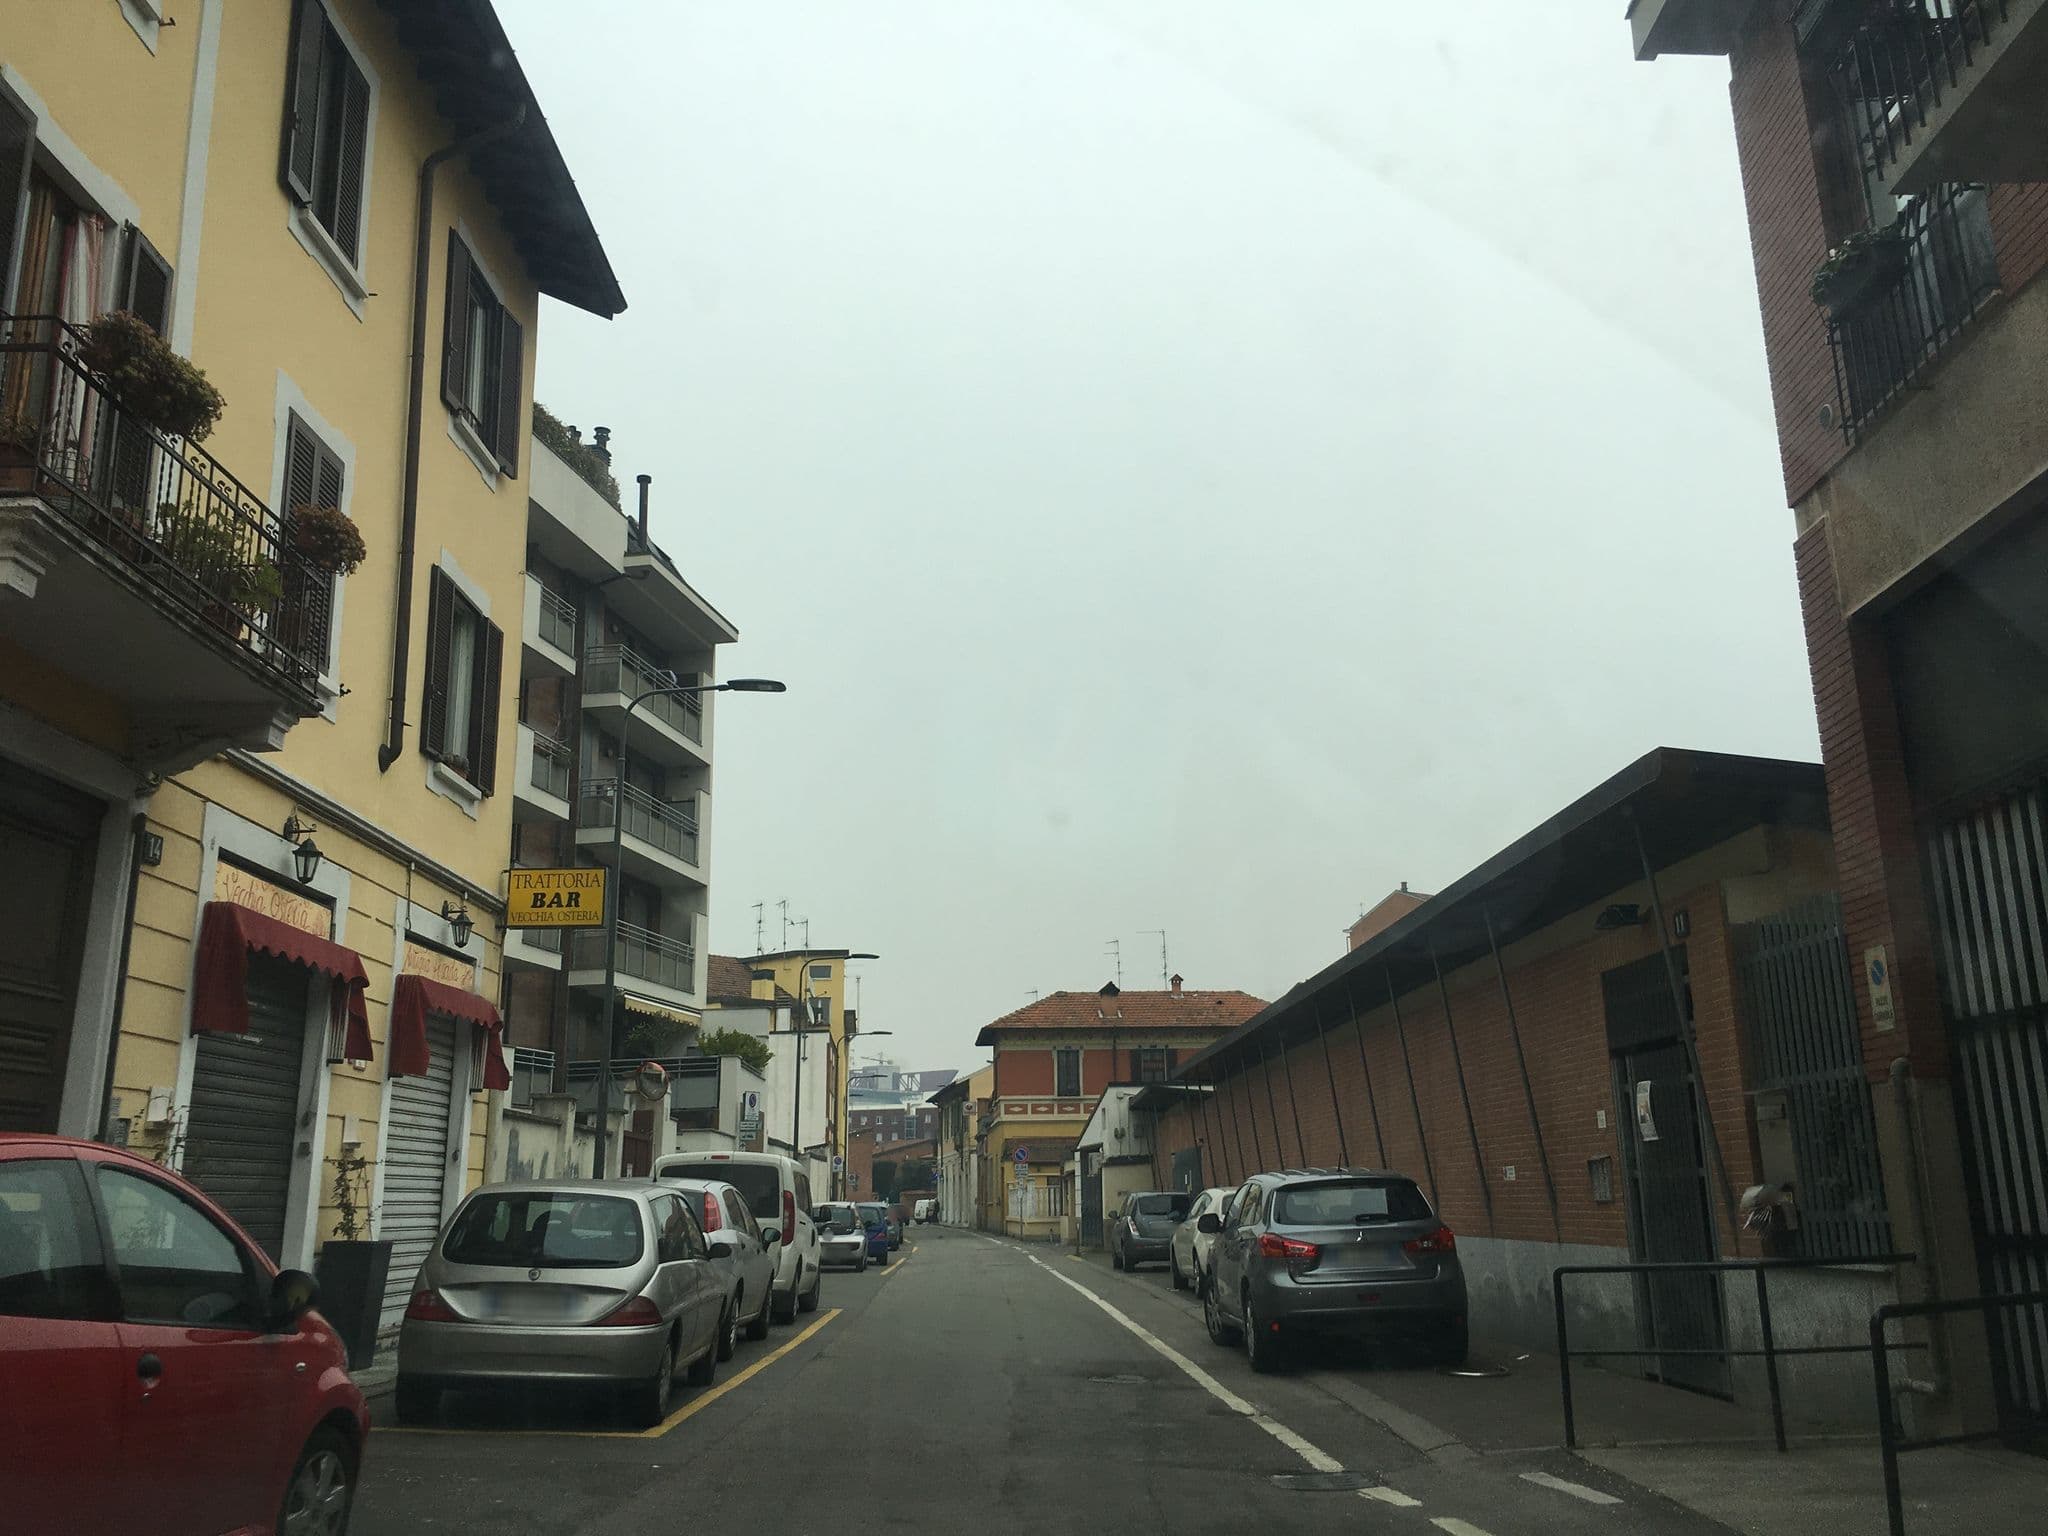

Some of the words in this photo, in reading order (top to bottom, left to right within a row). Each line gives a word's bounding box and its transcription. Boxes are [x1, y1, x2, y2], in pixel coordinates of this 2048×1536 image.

[513, 872, 601, 889] TRATTORIA
[530, 891, 581, 908] BAR
[511, 911, 554, 923] VECCHIA
[557, 910, 600, 922] OSTERIA
